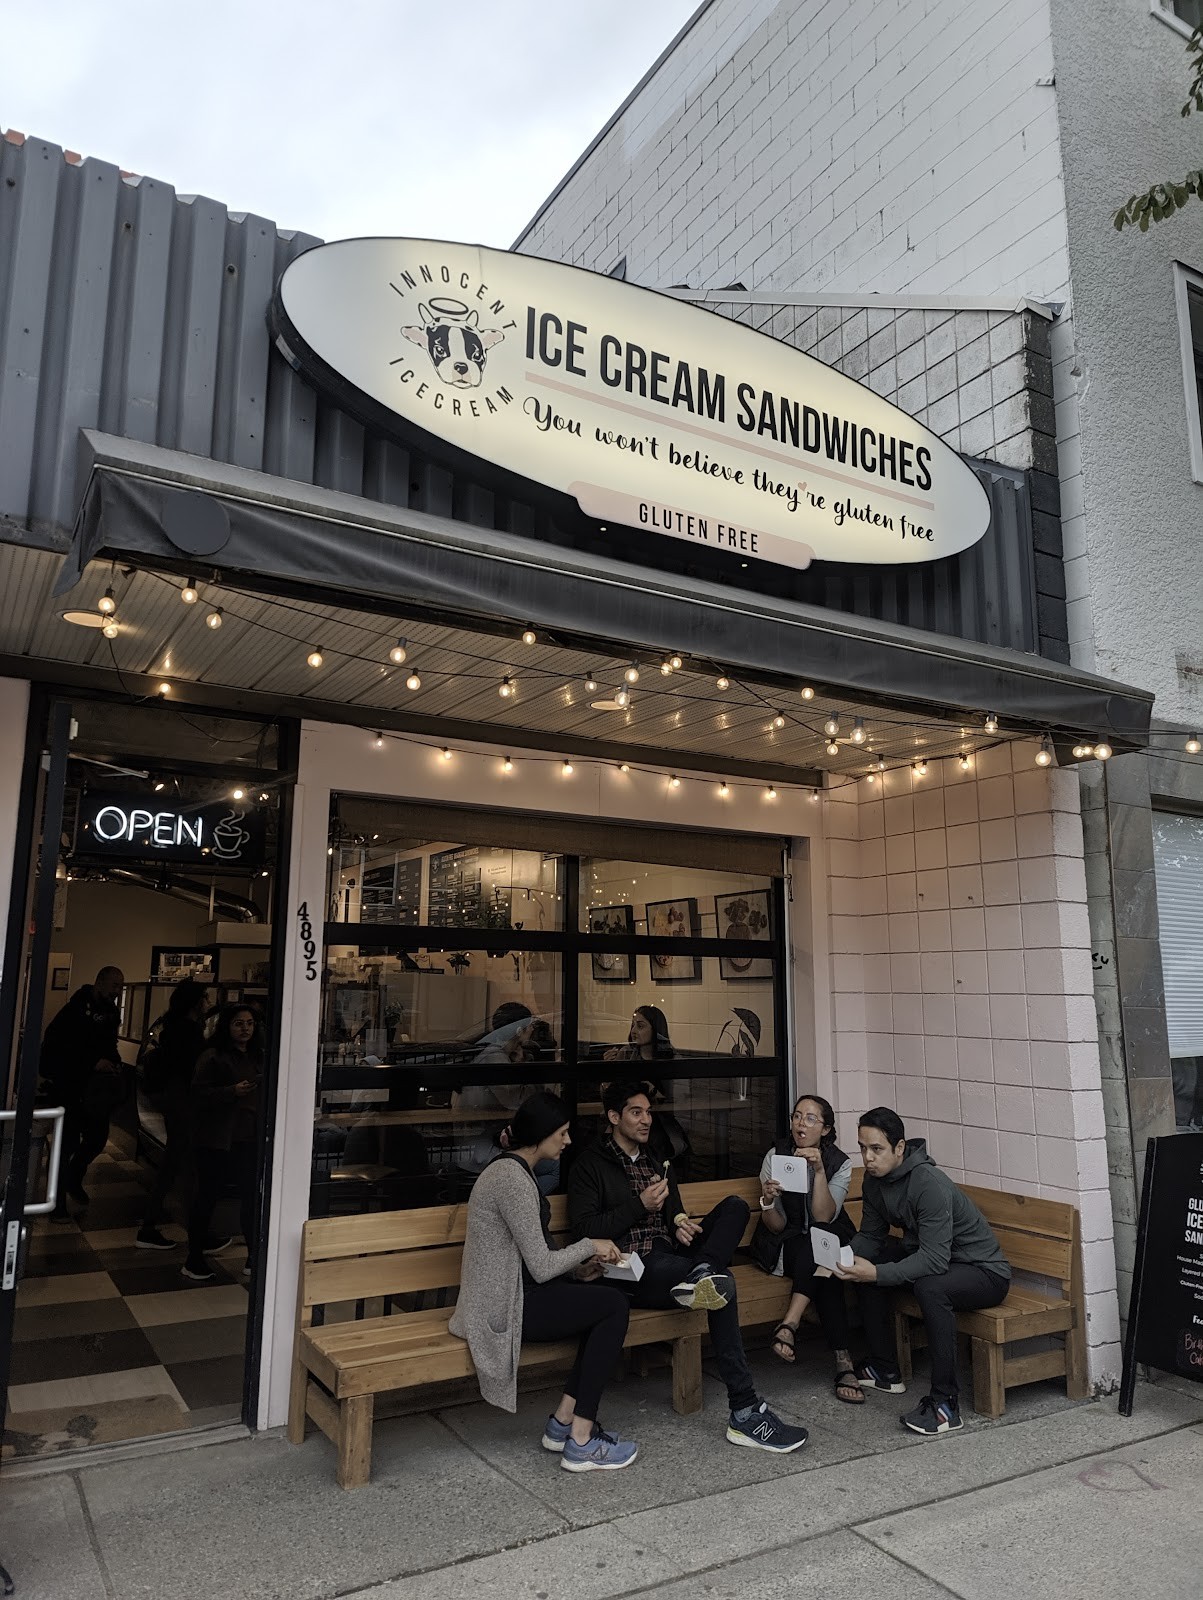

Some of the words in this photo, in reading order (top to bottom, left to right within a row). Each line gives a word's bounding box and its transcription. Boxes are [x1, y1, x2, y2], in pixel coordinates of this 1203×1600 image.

[389, 264, 517, 331] INNOCENT
[525, 306, 587, 377] ICE
[600, 334, 726, 423] CREAM
[737, 383, 932, 491] SANDWICHES
[523, 396, 582, 438] You
[595, 427, 659, 461] won't
[669, 443, 745, 485] believe
[833, 498, 894, 532] gluten
[900, 515, 935, 542] free
[639, 503, 708, 540] GLUTEN
[718, 524, 759, 553] FREE
[95, 805, 203, 847] OPEN
[297, 901, 317, 981] 4895
